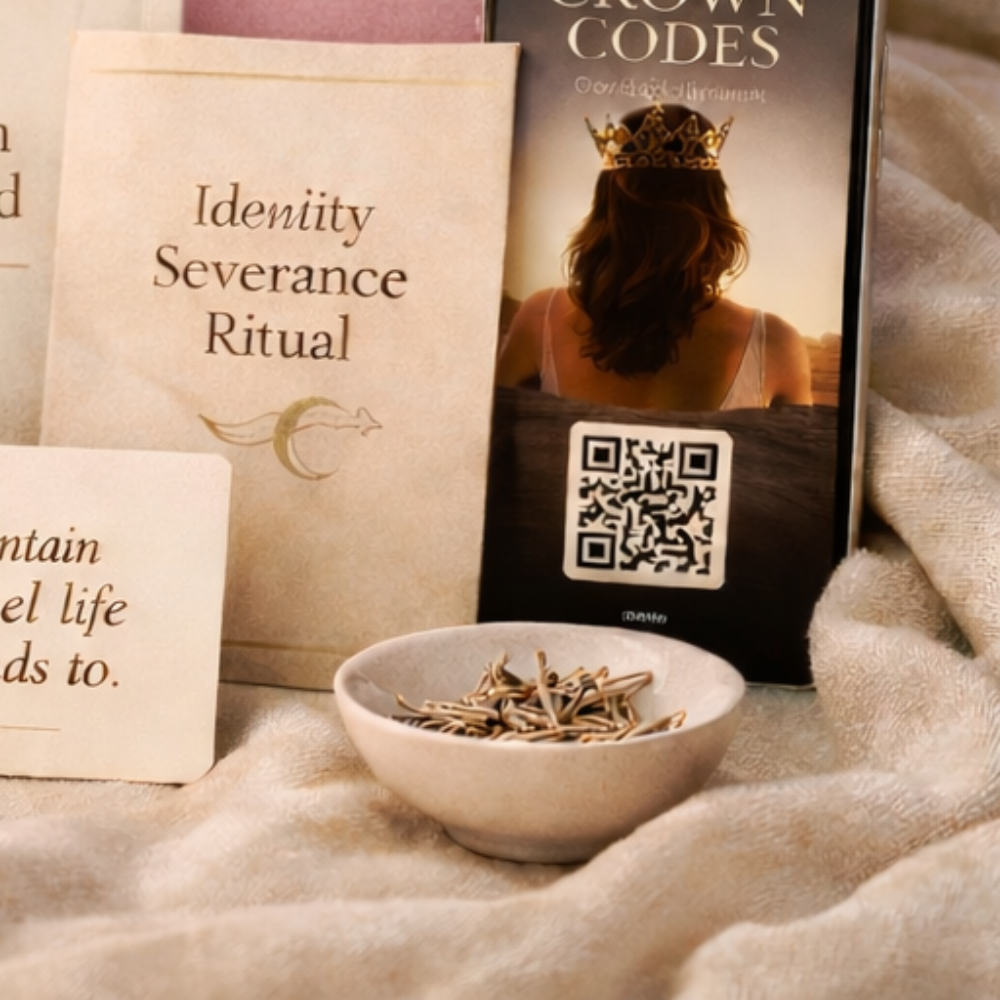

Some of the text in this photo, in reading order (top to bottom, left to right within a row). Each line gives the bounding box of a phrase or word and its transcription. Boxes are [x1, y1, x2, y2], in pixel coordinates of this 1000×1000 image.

[567, 16, 780, 69] CODES
[153, 243, 408, 300] Severance
[204, 311, 351, 362] Ritual
[60, 582, 128, 638] life
[67, 652, 120, 688] to.
